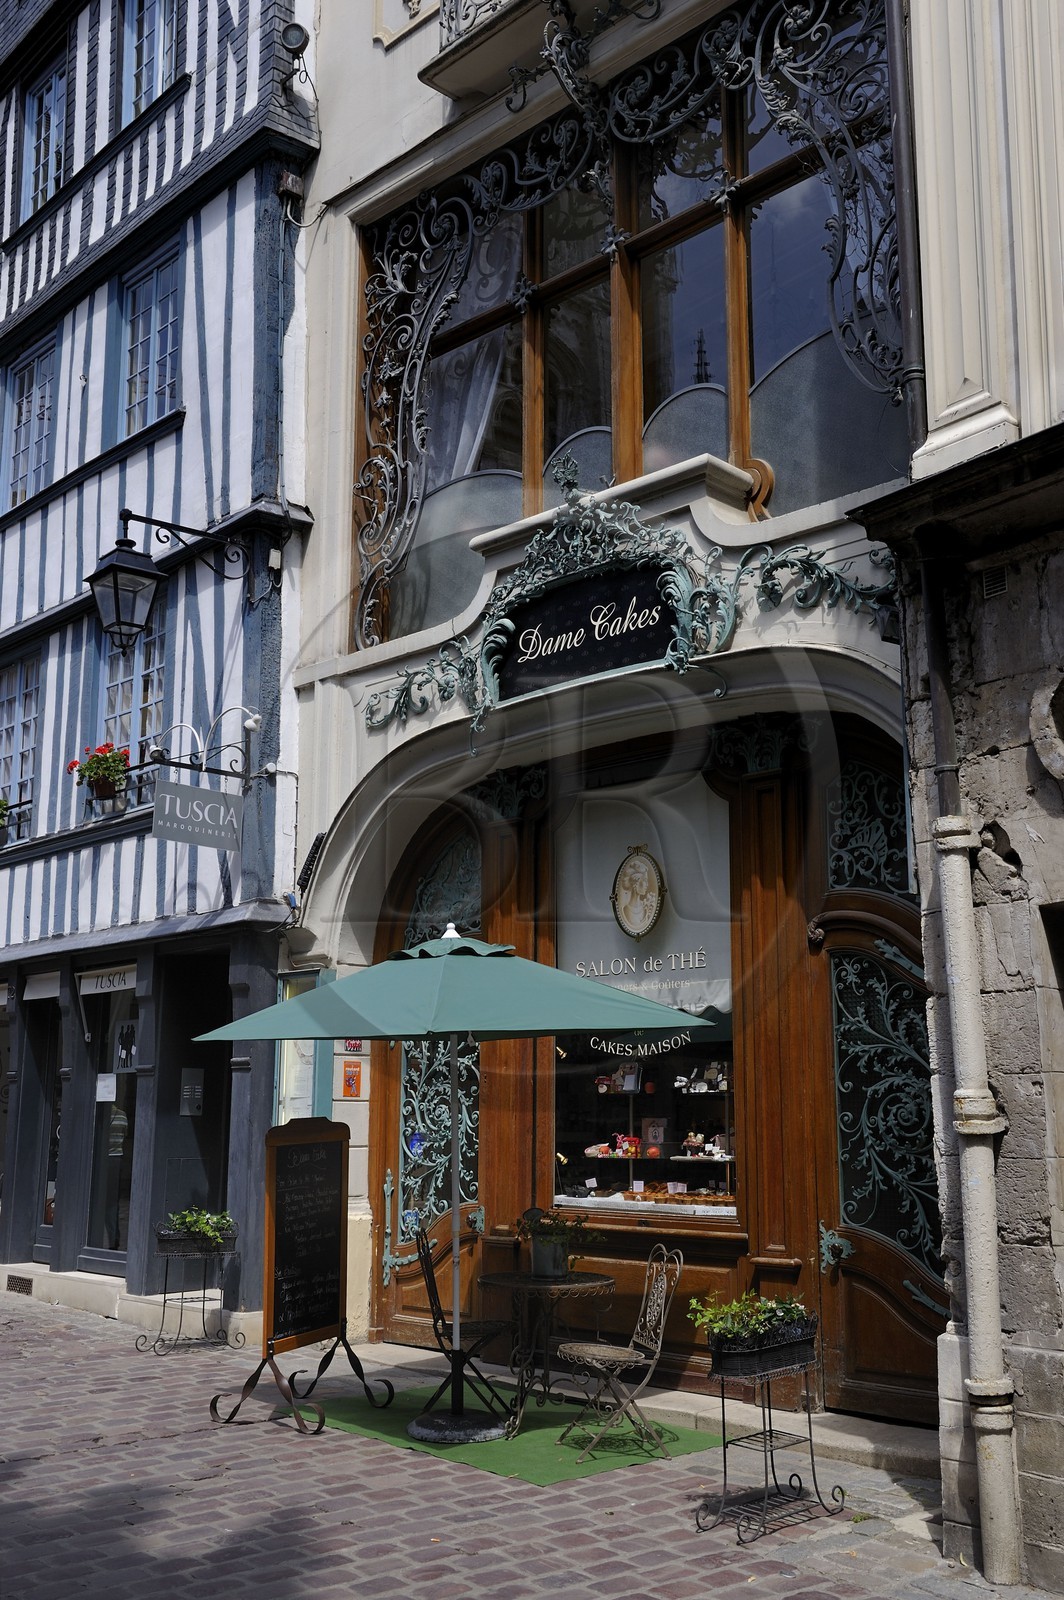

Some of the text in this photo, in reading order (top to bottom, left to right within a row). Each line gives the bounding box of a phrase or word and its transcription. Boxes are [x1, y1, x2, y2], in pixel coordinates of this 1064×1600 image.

[517, 595, 662, 664] Dame Cakes
[159, 793, 238, 829] TUSCIA
[157, 819, 237, 840] MAROQUINERIE
[575, 946, 707, 979] SALON de THÉ
[95, 971, 127, 990] TUSCIA
[651, 978, 691, 991] Goûters
[590, 1030, 692, 1057] CAKES MAISON
